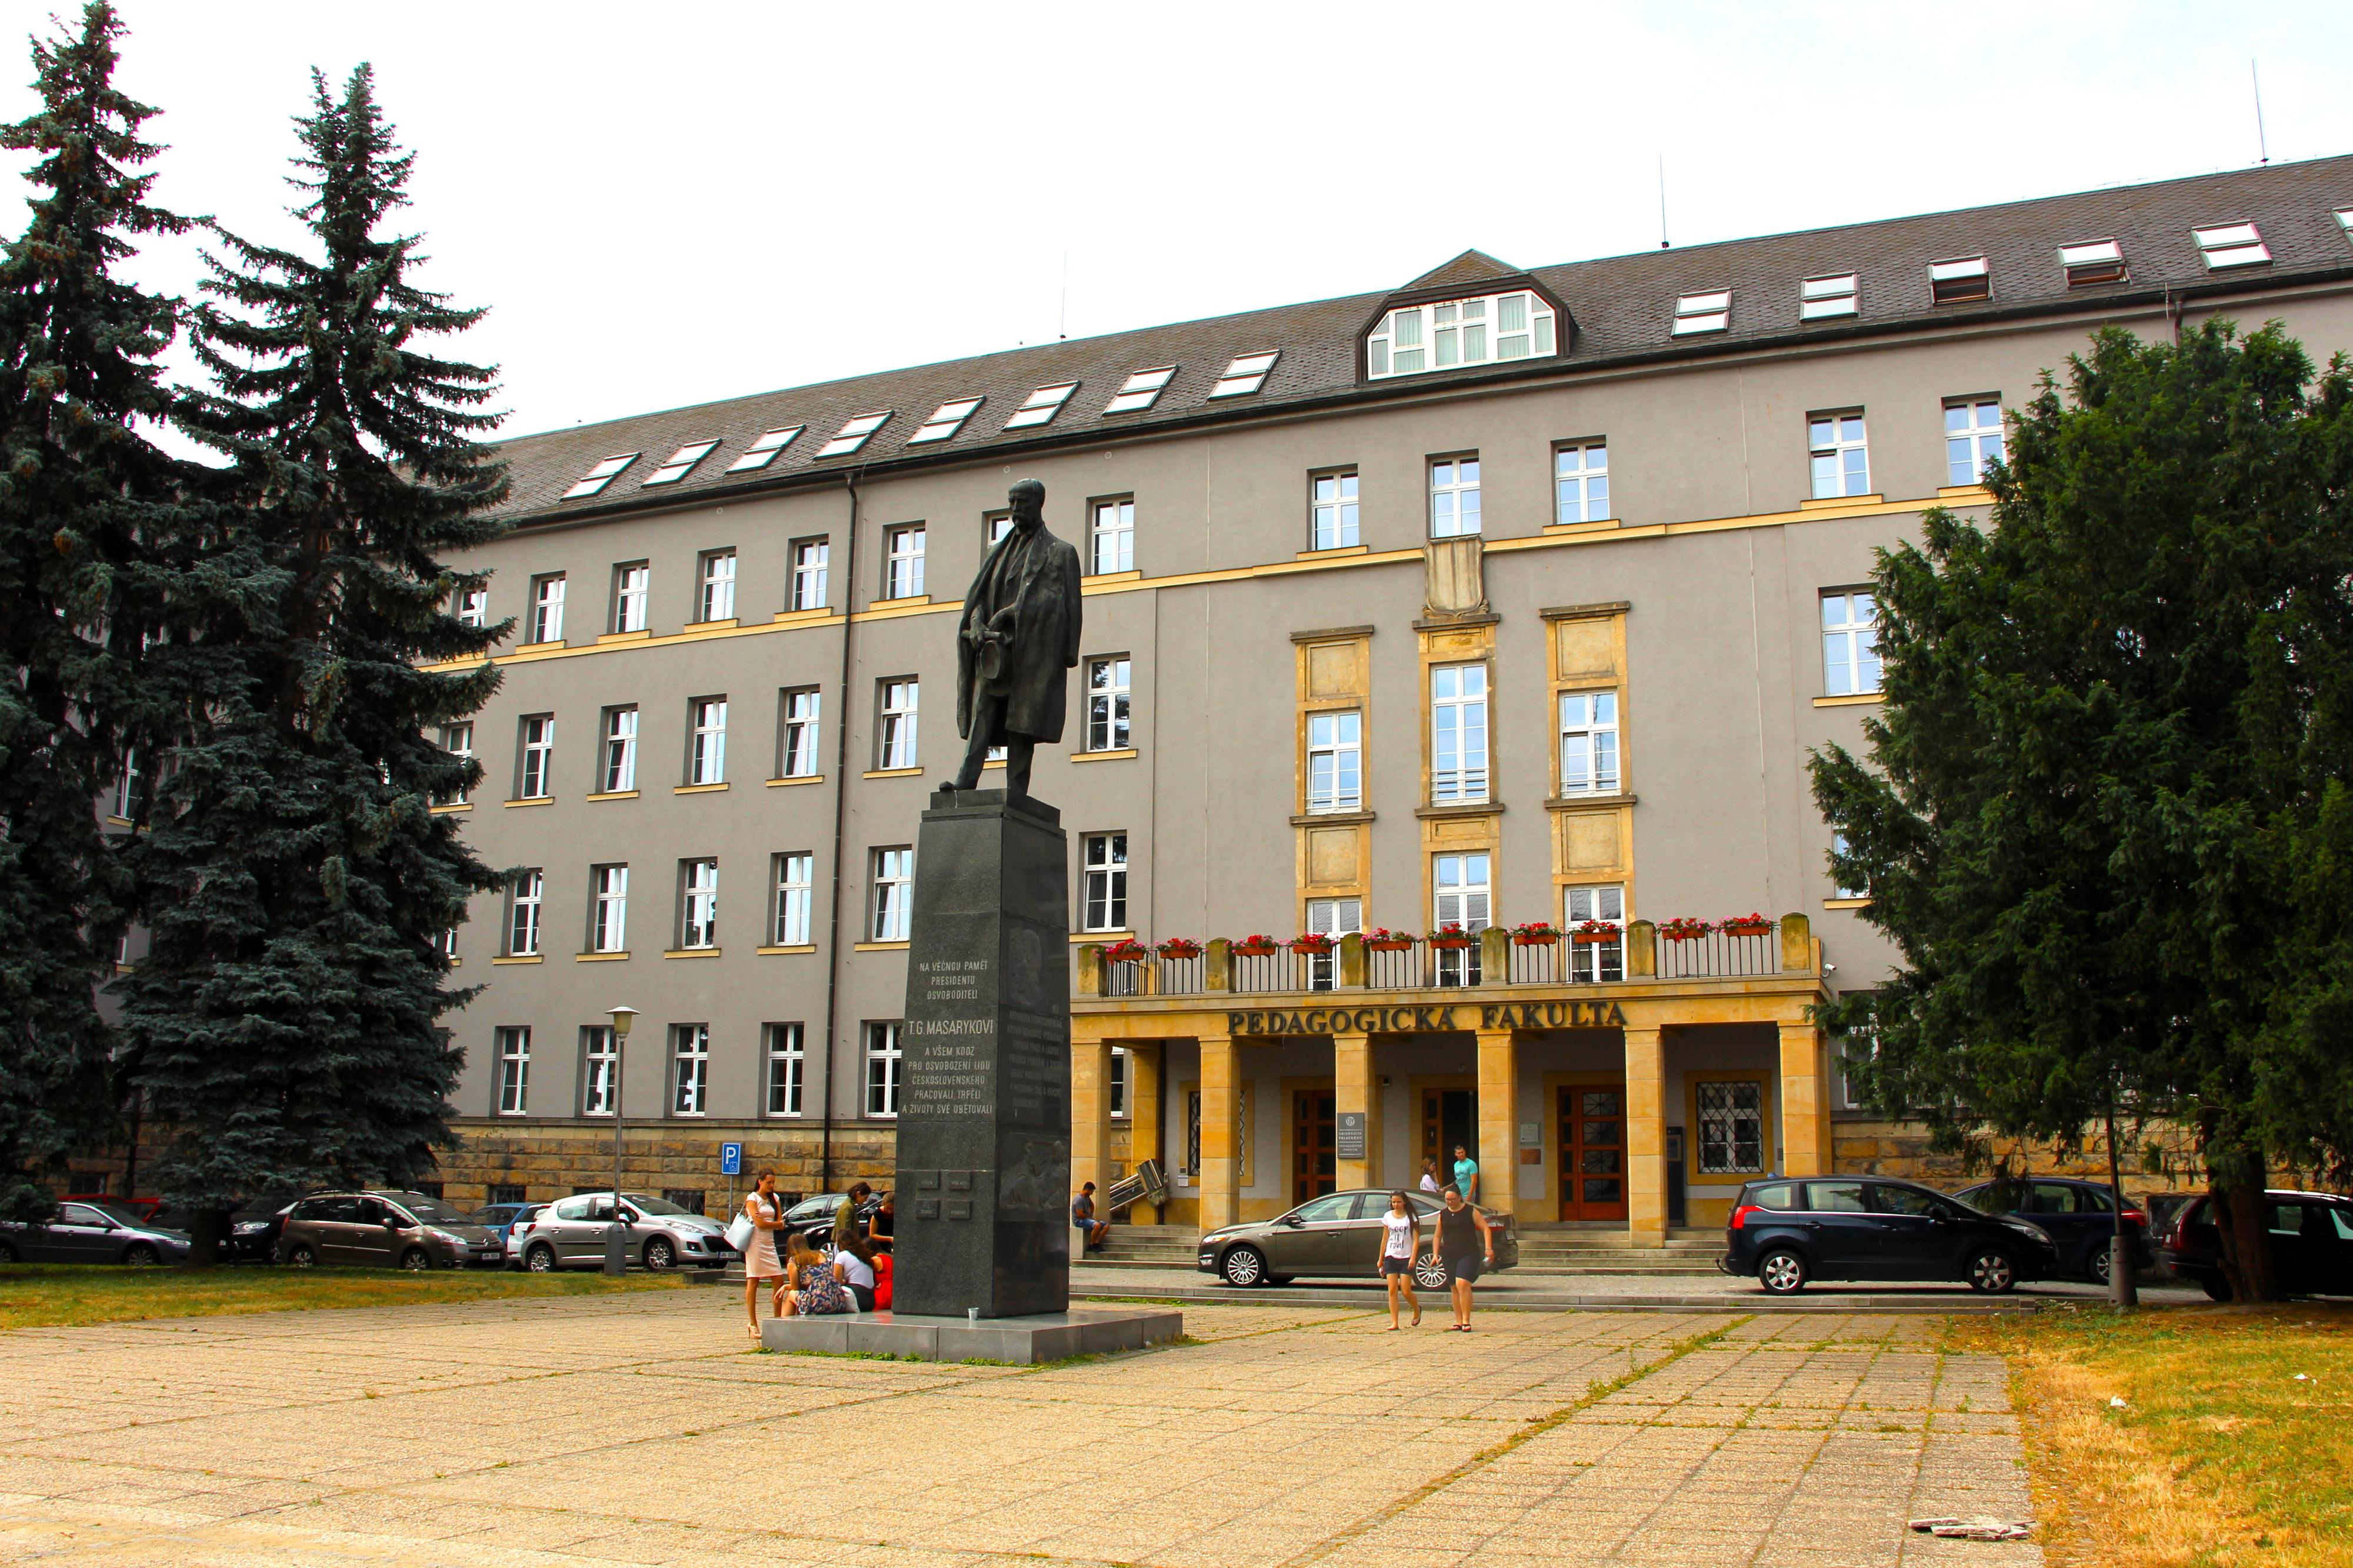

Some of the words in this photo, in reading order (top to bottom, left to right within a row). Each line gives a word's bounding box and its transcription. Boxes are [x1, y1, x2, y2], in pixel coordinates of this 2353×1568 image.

[919, 962, 929, 972] NA
[932, 960, 961, 972] VĚČNOU
[931, 976, 975, 985] PRESIDENTU
[927, 989, 977, 1000] OSVOBODITELI
[1227, 1006, 1455, 1034] PEDAGOGICKÁ
[1480, 1002, 1627, 1029] FAKULTA
[926, 1019, 993, 1035] MASARYKOVI
[924, 1047, 929, 1056] A
[908, 1061, 922, 1070] PRO
[925, 1059, 970, 1070] OSVOBOZENÍ
[974, 1060, 991, 1070] LIDU
[902, 1105, 908, 1113] A
[909, 1102, 933, 1113] ŽIVOTY
[954, 1103, 992, 1113] OBĚTOVALI
[726, 1147, 736, 1165] P
[1389, 1240, 1404, 1249] real
